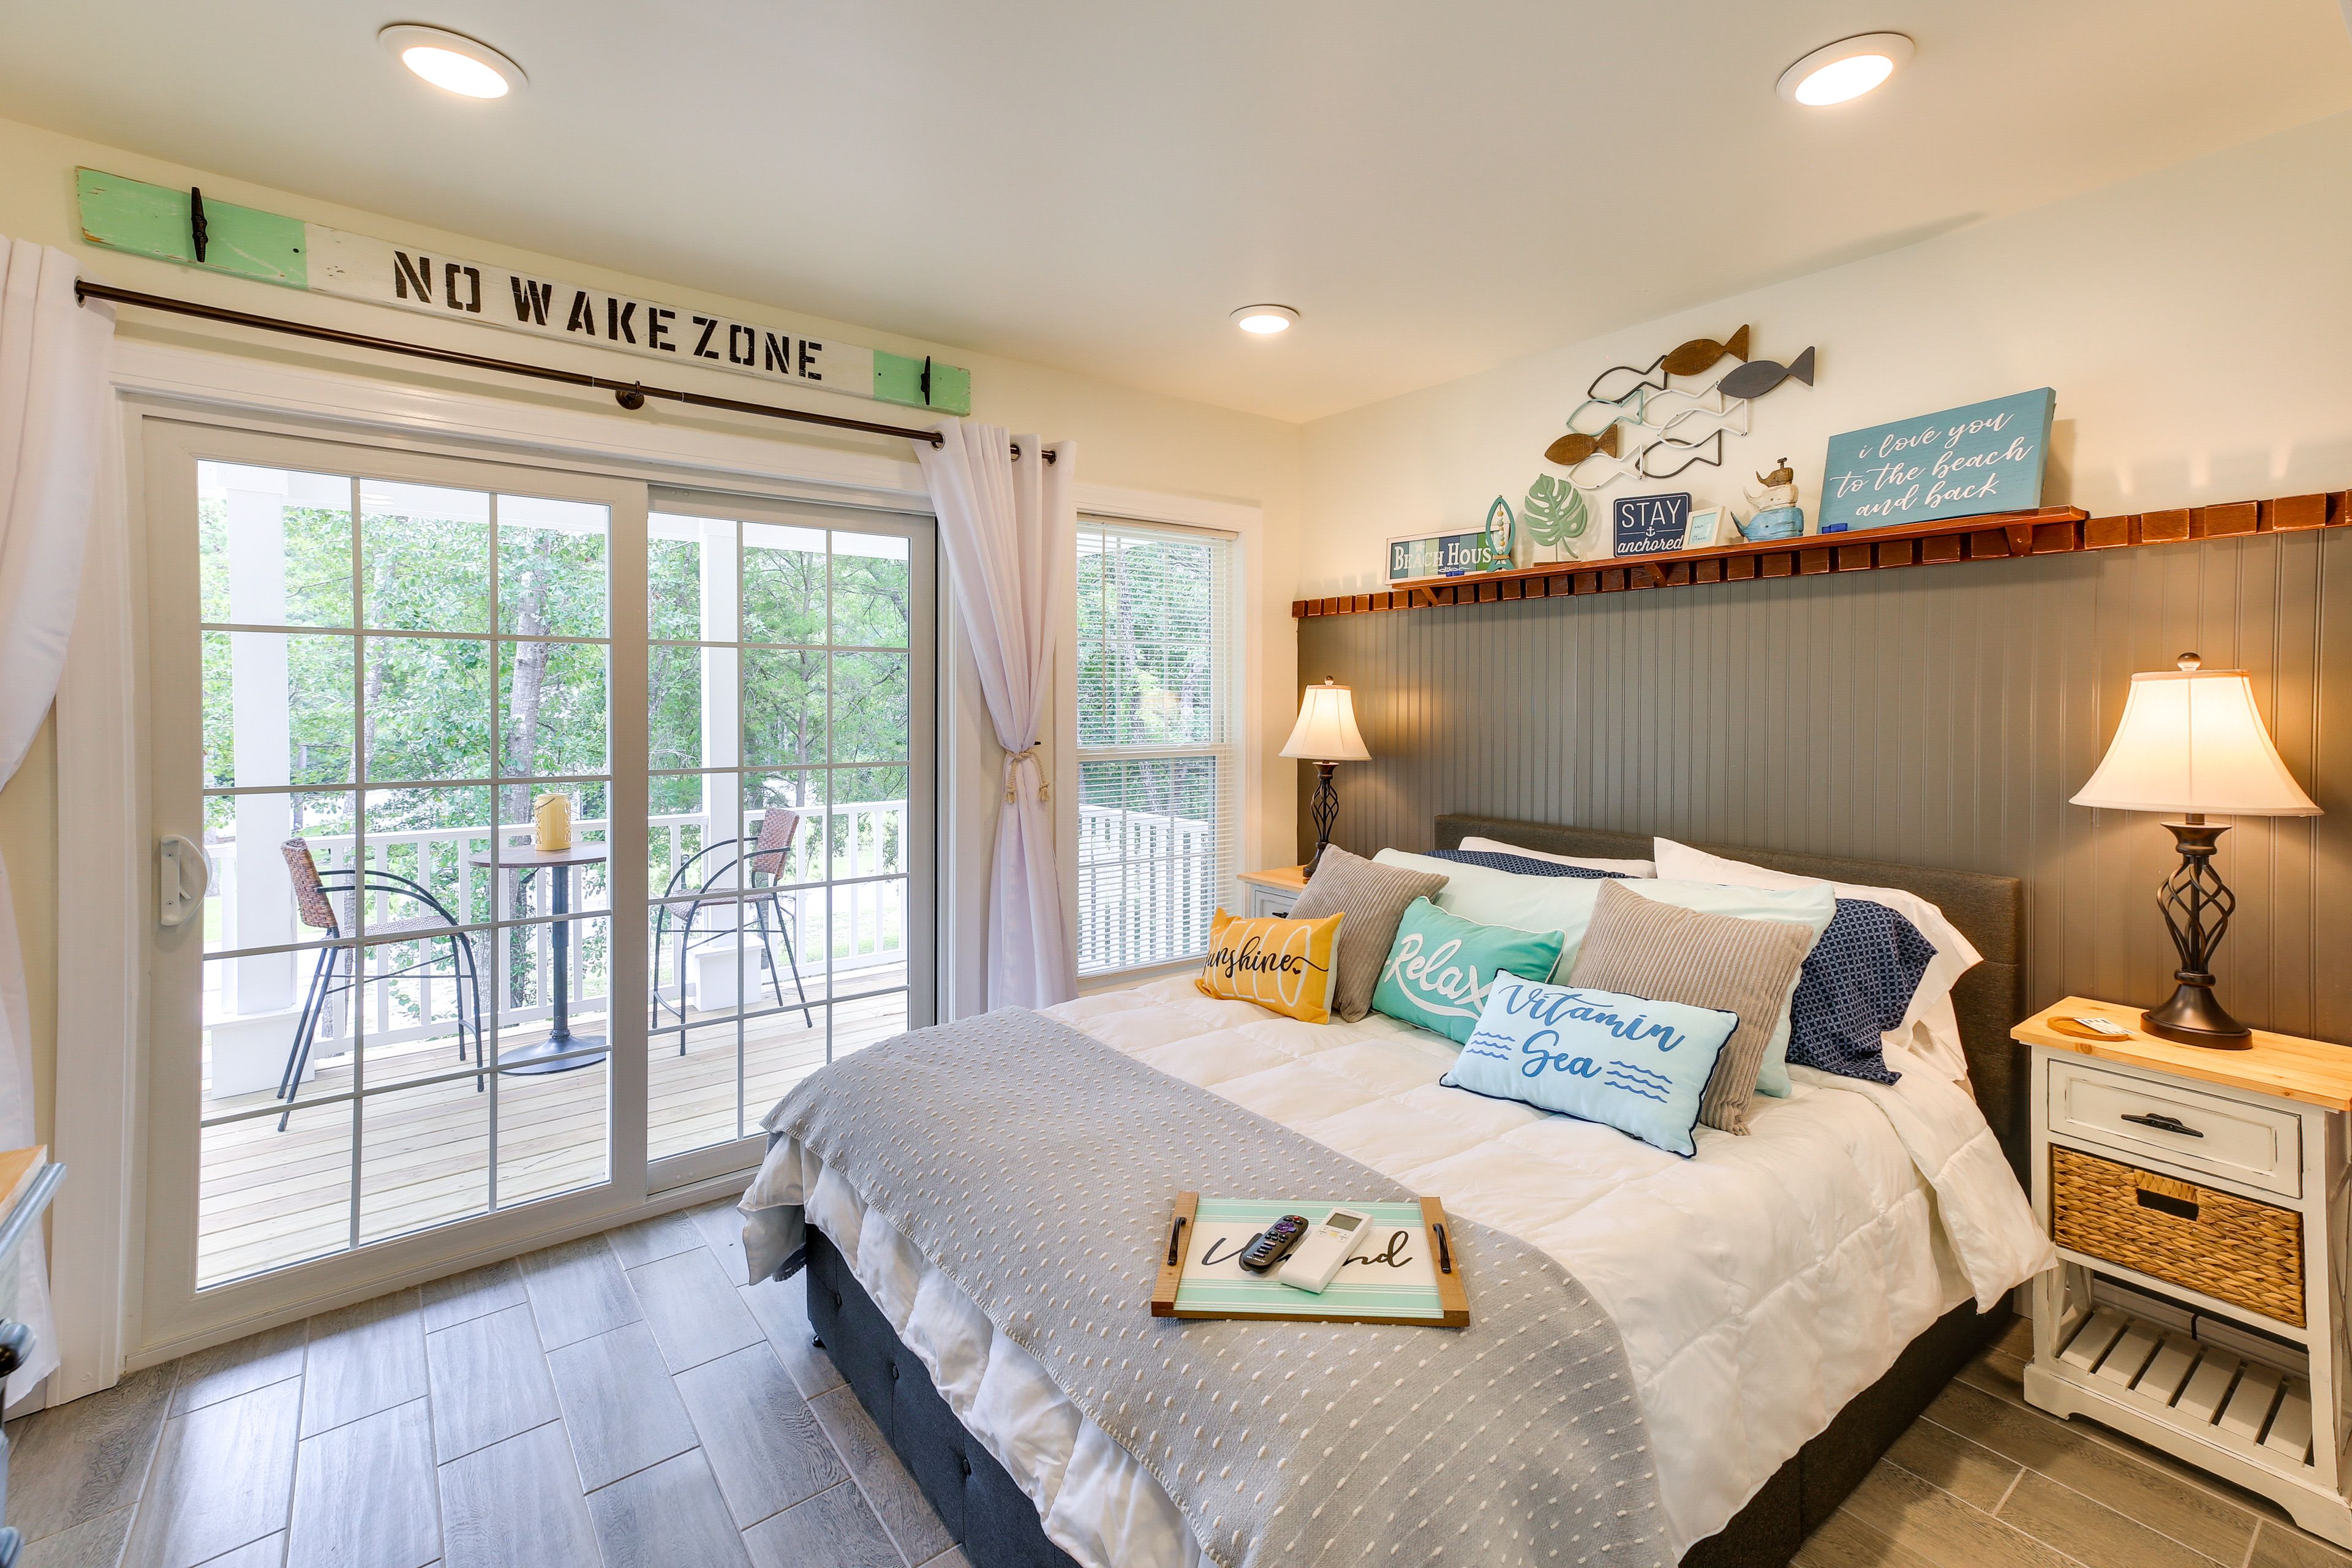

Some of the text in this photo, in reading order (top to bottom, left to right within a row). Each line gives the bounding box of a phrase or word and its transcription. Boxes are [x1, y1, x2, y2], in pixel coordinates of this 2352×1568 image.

[394, 251, 822, 380] NO WAKE ZONE
[1858, 413, 2014, 459] i love you
[1830, 436, 2034, 498] to the beach
[1622, 499, 1681, 527] STAY
[1855, 472, 1999, 516] and back
[1393, 543, 1492, 571] BEACH HOUS
[1618, 535, 1684, 553] anchored
[1384, 933, 1493, 1020] Relax
[1498, 985, 1686, 1052] Vitamin
[1521, 1030, 1602, 1077] Sea
